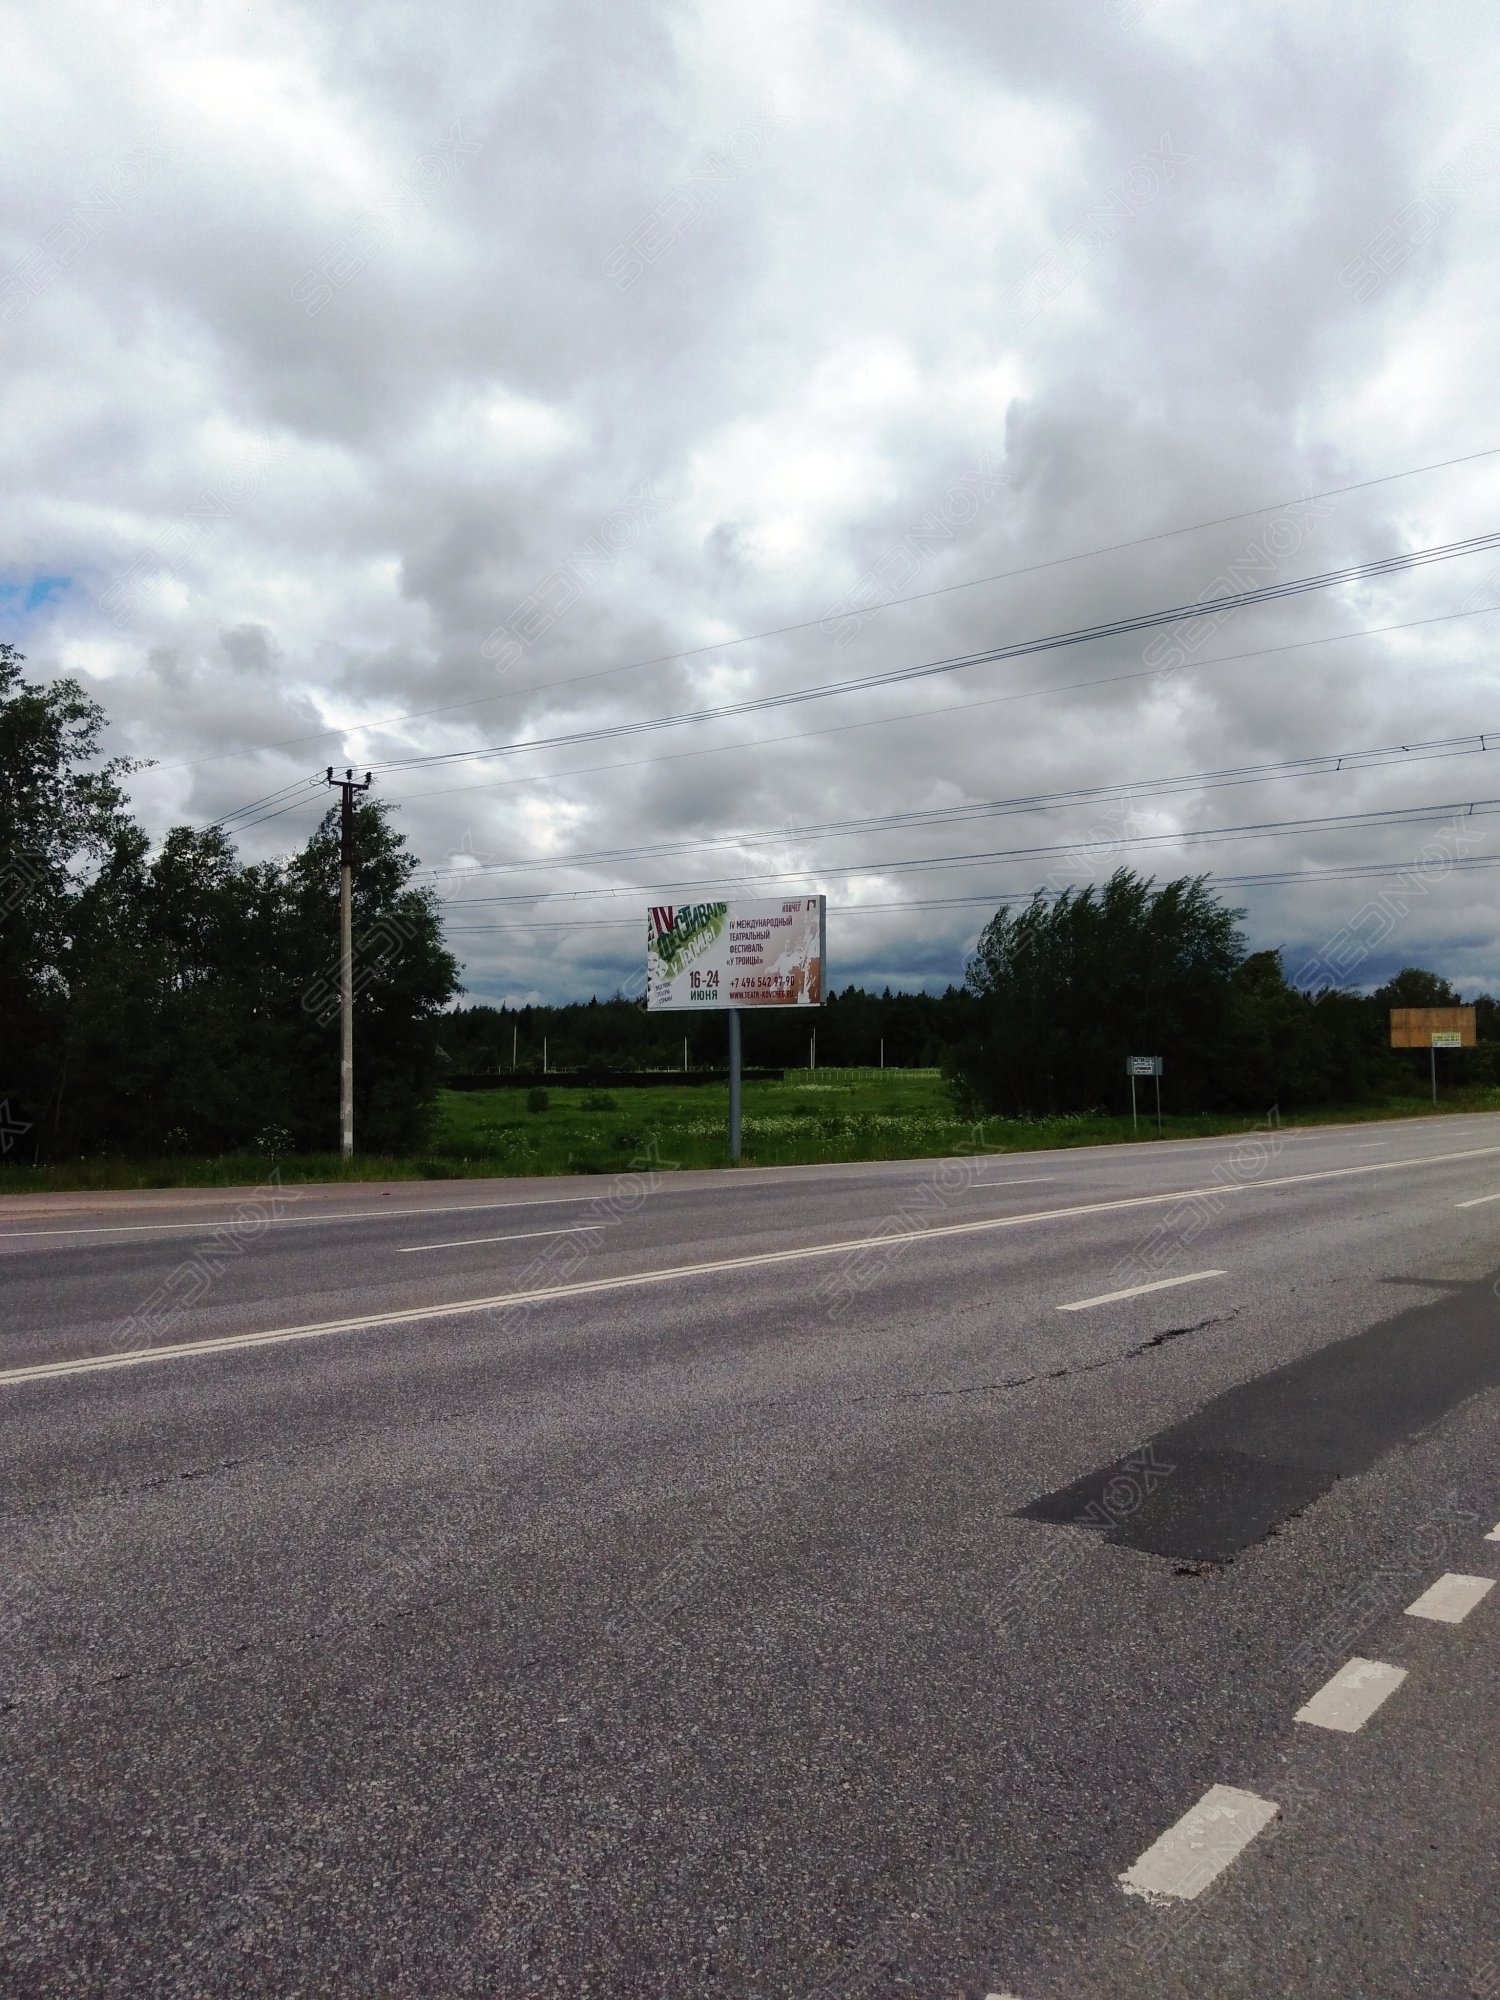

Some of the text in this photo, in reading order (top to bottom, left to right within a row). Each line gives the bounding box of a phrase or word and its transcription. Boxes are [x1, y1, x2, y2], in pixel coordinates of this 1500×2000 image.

[652, 906, 673, 935] IV
[736, 916, 793, 929] МЕЖДУНАРОДНЫЙ
[729, 930, 770, 942] ТЕАТРАЛЬНЫЙ
[729, 944, 764, 953] ФЕСТИВАЛЬ
[690, 970, 720, 988] 16-24
[730, 975, 795, 988] +7 496 542 97-90
[690, 989, 718, 1001] ИЮНЯ
